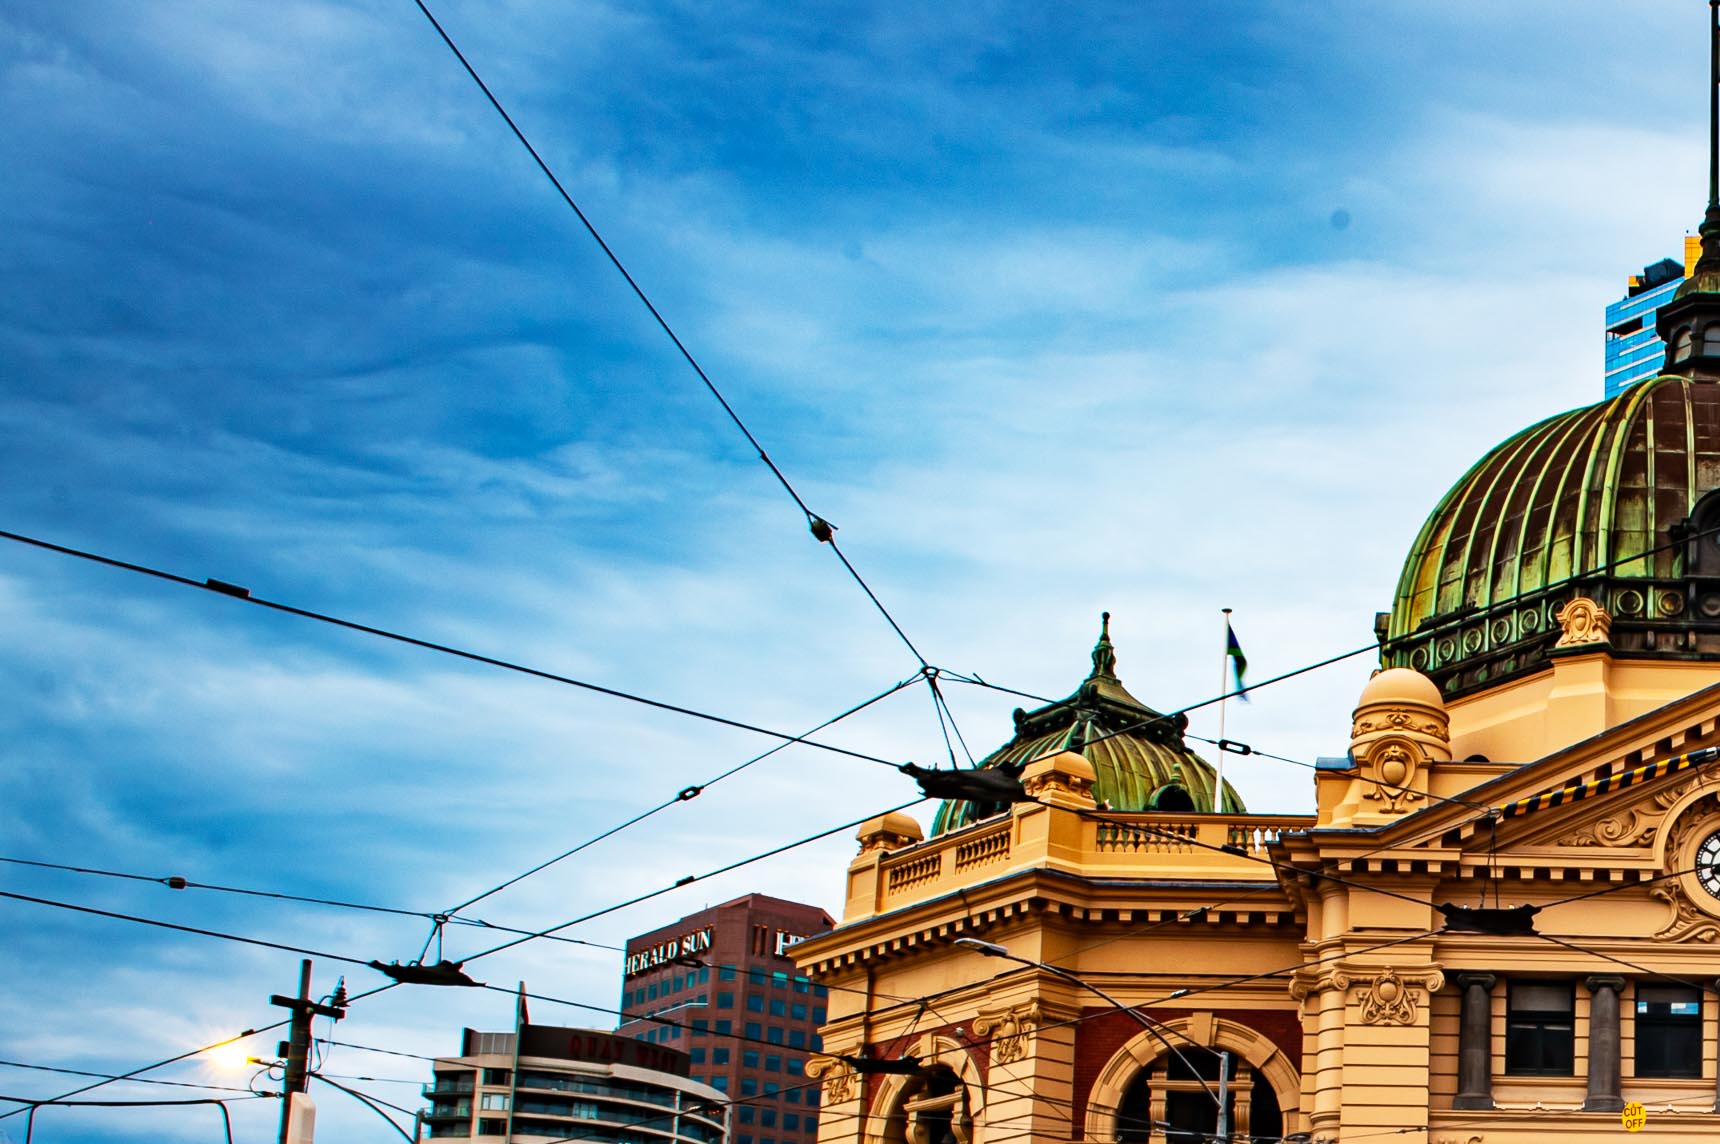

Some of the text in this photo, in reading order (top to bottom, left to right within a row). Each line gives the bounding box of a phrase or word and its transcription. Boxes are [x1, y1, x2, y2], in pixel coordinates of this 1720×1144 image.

[625, 928, 711, 976] HERALD SUN
[1623, 1106, 1643, 1117] CUT
[1625, 1118, 1643, 1129] OFF
